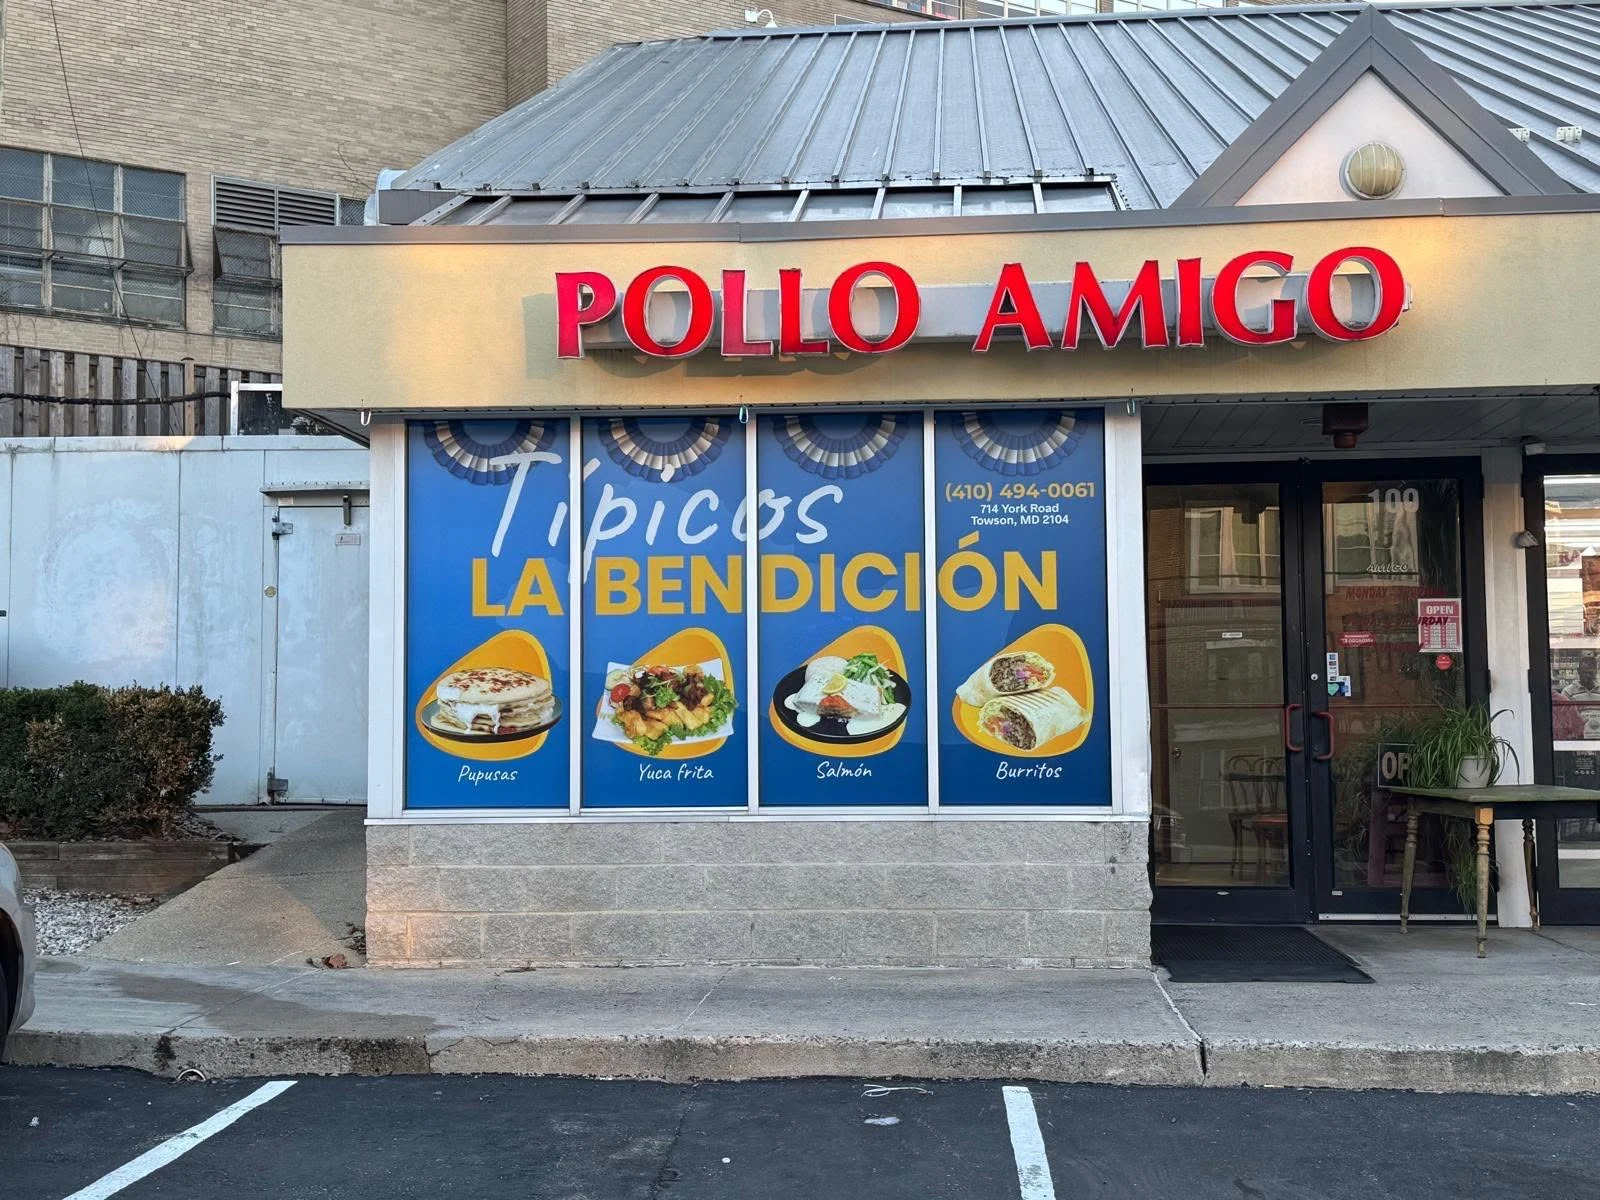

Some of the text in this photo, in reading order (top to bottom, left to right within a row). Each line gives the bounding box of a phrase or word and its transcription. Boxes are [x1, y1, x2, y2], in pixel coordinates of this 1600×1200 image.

[554, 246, 1410, 359] POLLO AMIGO
[945, 482, 1095, 502] (410) 494-0061
[1367, 487, 1420, 514] 100
[489, 451, 844, 585] Típicos
[980, 502, 1060, 514] 714 York Road
[971, 514, 1069, 527] Towson, MD 2104
[472, 531, 1058, 617] LA BENDICIÓN
[1425, 605, 1454, 615] OPEN
[456, 764, 519, 785] Pupusas
[638, 763, 715, 781] Yuca frita
[815, 760, 873, 780] Salmón
[995, 761, 1063, 780] Burritos
